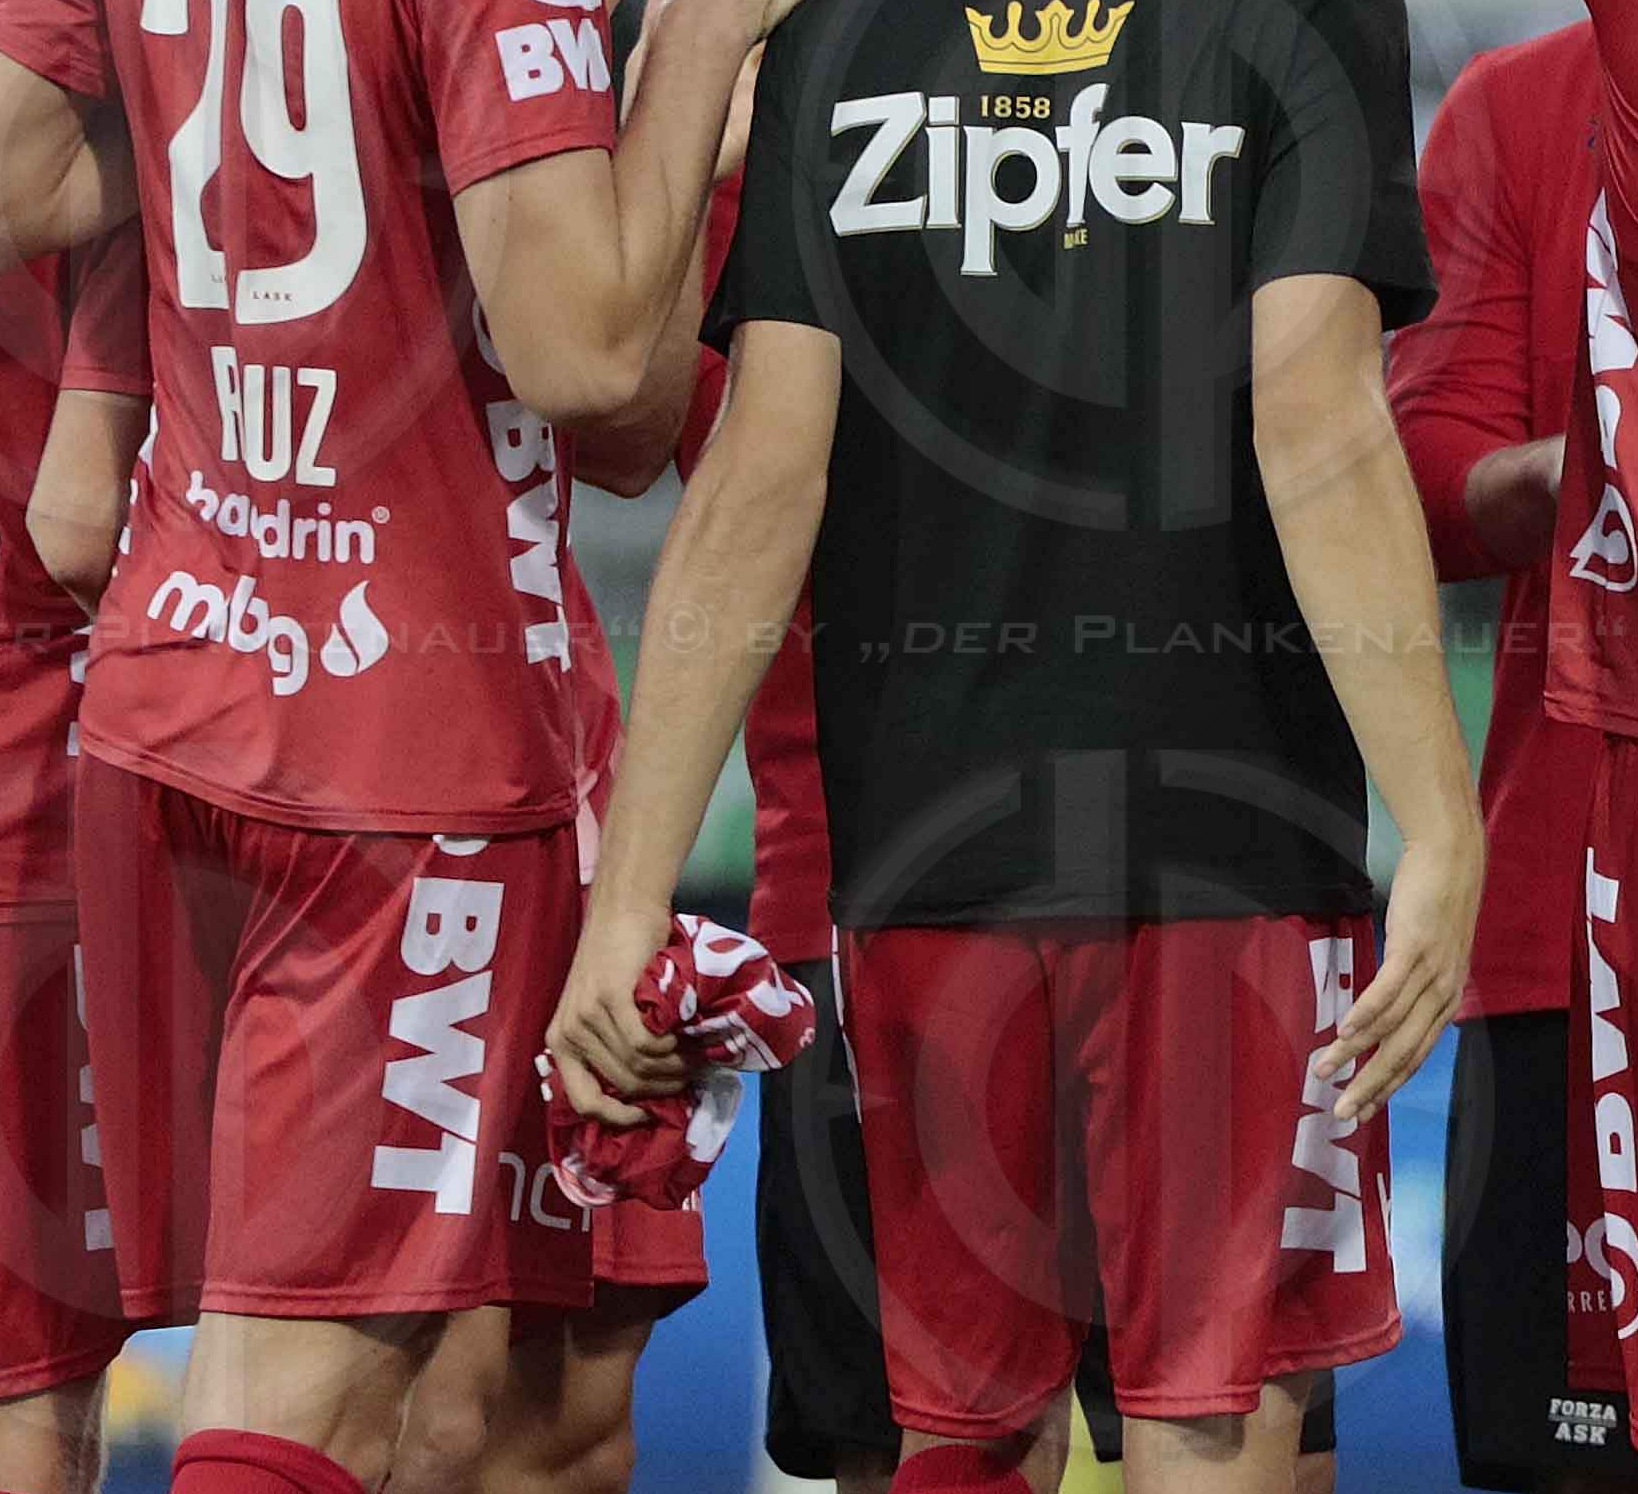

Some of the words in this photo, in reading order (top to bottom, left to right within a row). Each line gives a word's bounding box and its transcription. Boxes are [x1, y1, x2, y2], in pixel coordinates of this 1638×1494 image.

[980, 93, 1052, 119] 1858
[828, 82, 1246, 277] Zipfer
[371, 876, 506, 1214] BWT
[1548, 1396, 1618, 1421] FORZA
[1554, 1422, 1607, 1445] ASK
